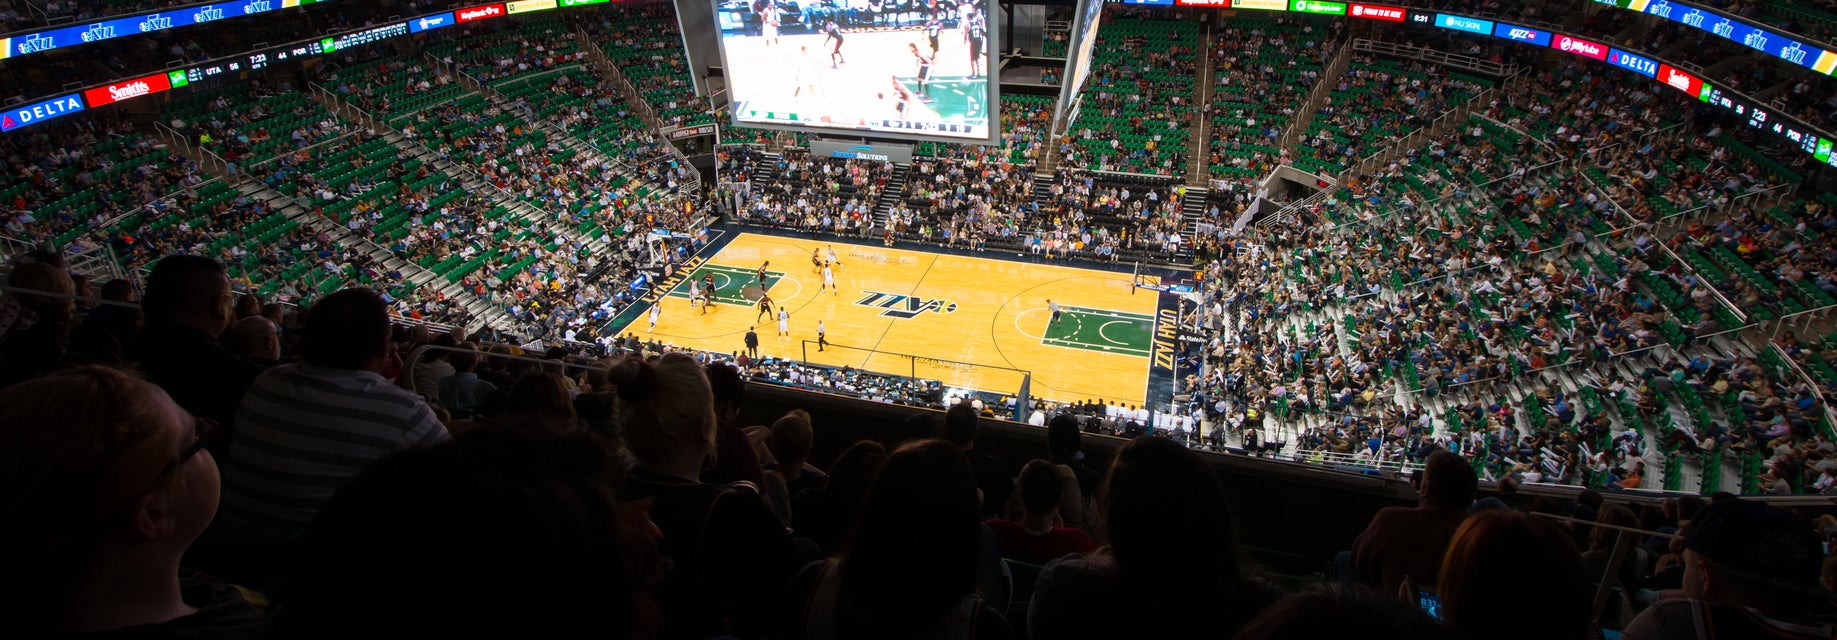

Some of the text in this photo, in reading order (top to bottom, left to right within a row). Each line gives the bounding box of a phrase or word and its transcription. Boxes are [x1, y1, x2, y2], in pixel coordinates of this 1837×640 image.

[277, 51, 288, 60] 44
[292, 47, 307, 57] POR
[249, 53, 267, 64] 7:23
[1621, 54, 1656, 75] DELTA
[205, 66, 222, 76] UTA
[1721, 97, 1732, 108] UTA
[19, 98, 80, 122] DELTA
[1787, 129, 1801, 142] POR
[1153, 309, 1177, 371] UTAH JAZZ
